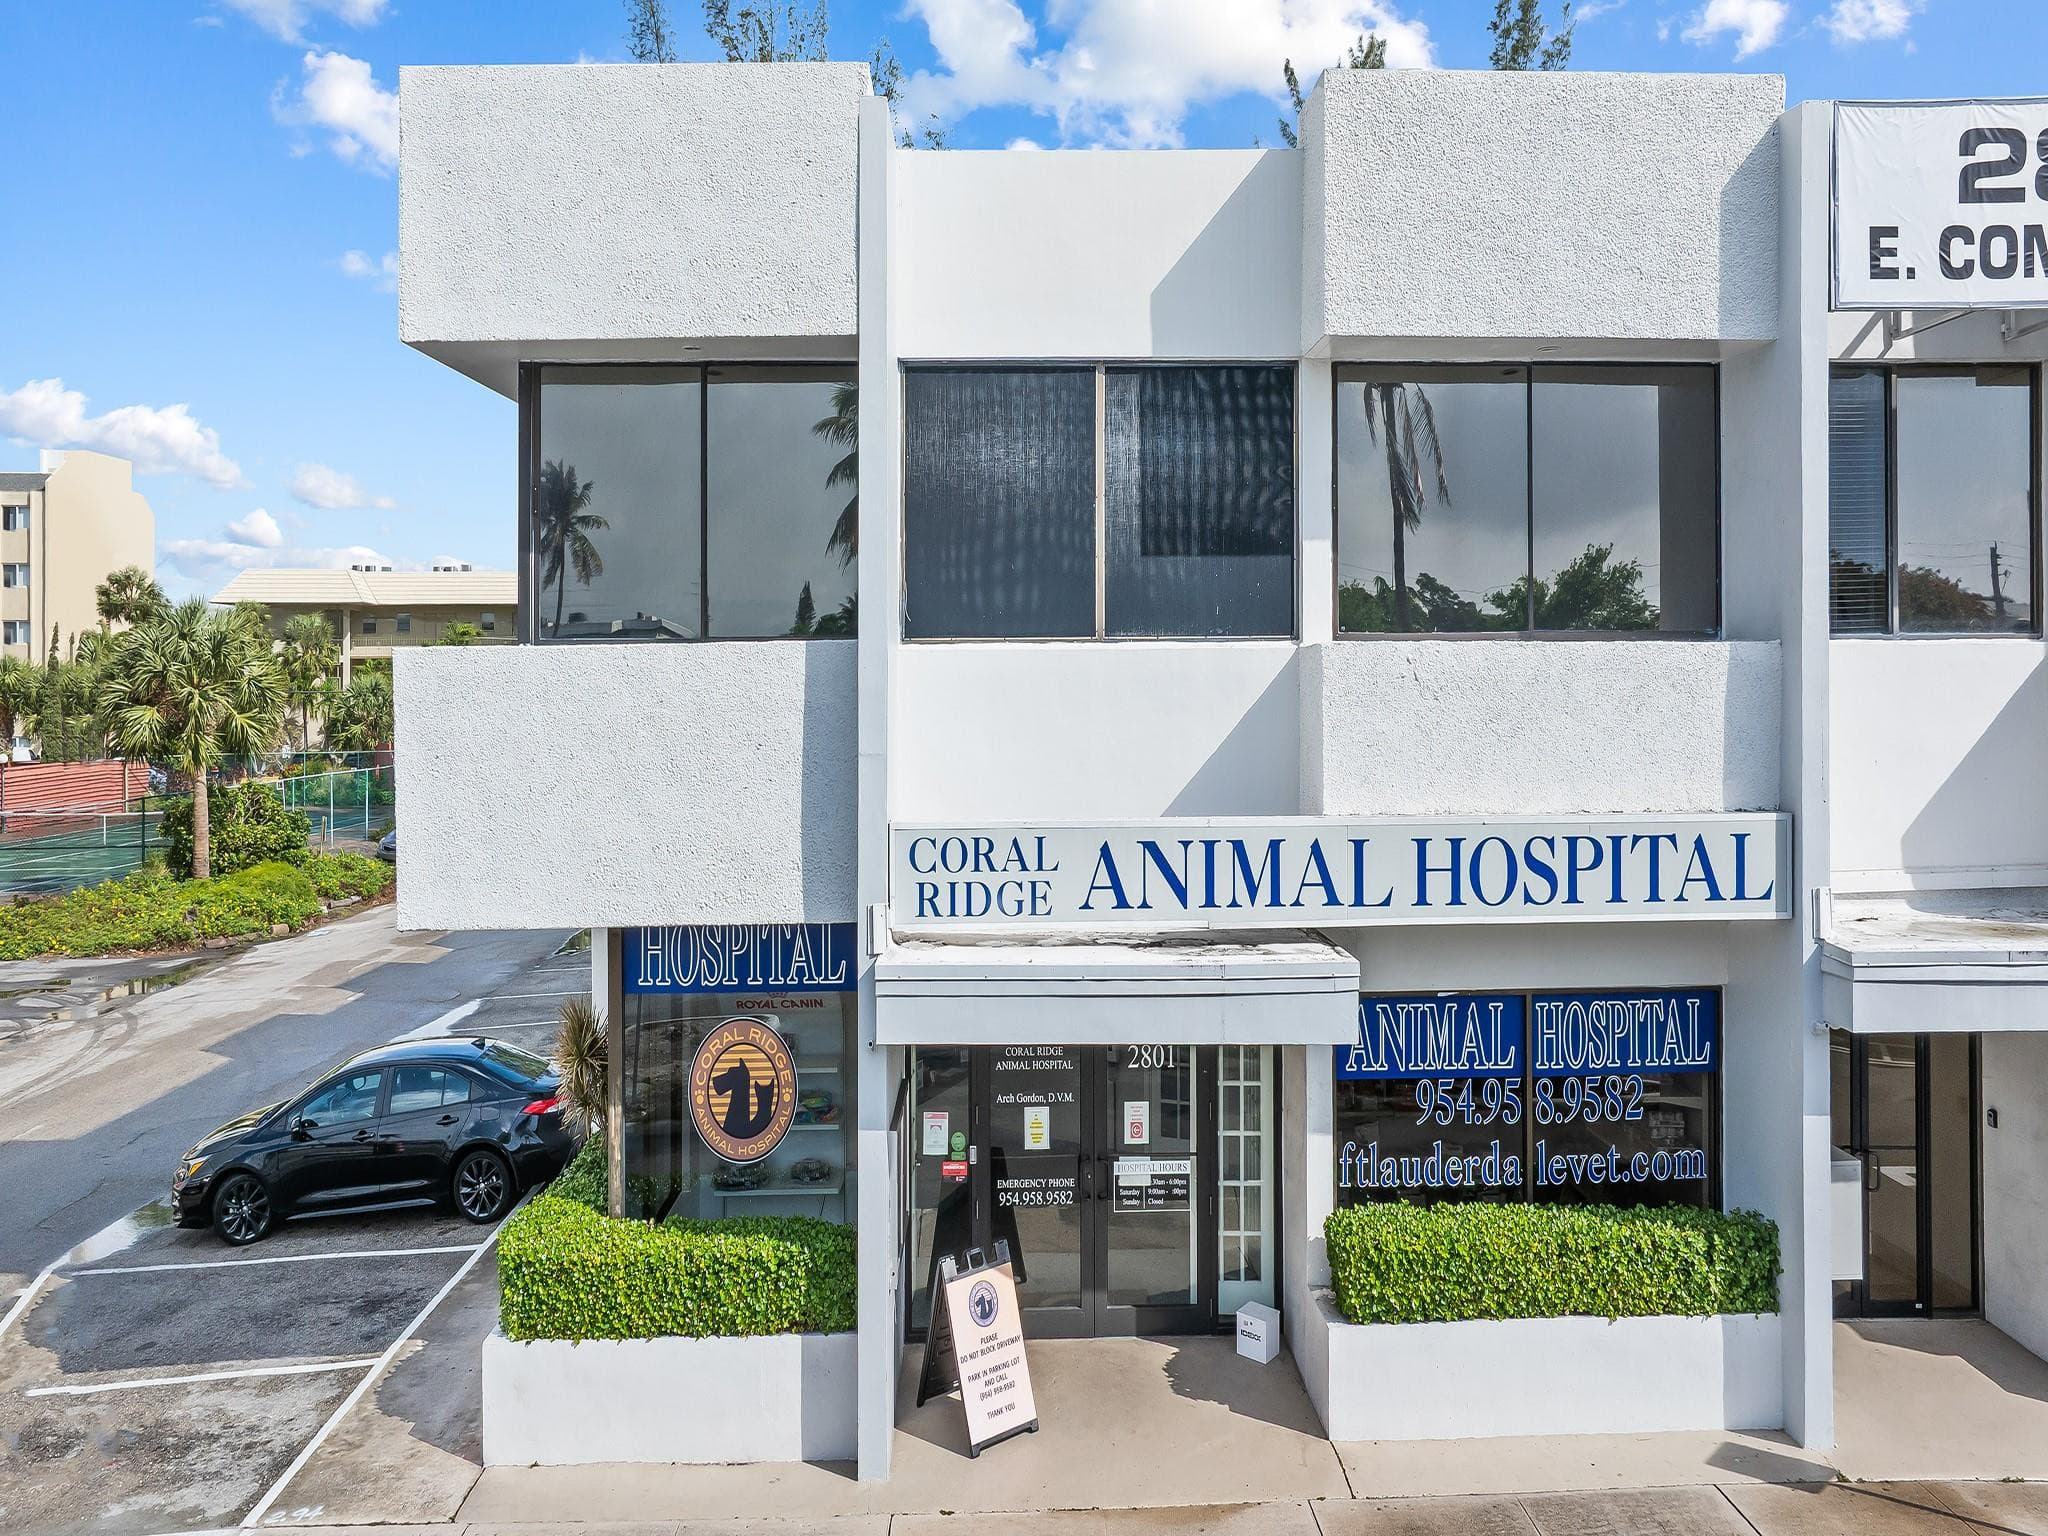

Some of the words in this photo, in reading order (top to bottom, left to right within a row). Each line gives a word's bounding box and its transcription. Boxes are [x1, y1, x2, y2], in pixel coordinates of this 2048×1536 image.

[1959, 127, 2048, 204] 2
[1869, 226, 1916, 280] E.
[909, 835, 1060, 874] CORAL
[1078, 837, 1394, 910] ANIMAL
[1411, 832, 1774, 907] HOSPITAL
[914, 880, 1054, 918] RIDGE
[638, 923, 847, 987] HOSPITAL
[736, 999, 778, 1010] ROYAL
[780, 998, 824, 1009] CANIN
[1345, 1002, 1516, 1072] ANIMAL
[1536, 998, 1711, 1070] HOSPITAL
[696, 1027, 745, 1086] CORAL
[749, 1027, 792, 1085] RIDGE
[1005, 1046, 1035, 1057] CORAL
[1037, 1046, 1064, 1056] RIDGE
[1127, 1044, 1175, 1069] 2801
[995, 1060, 1031, 1071] ANIMAL
[1032, 1060, 1074, 1070] HOSPITAL
[996, 1093, 1015, 1104] Arch
[1016, 1092, 1047, 1105] Gordon,
[1048, 1092, 1075, 1103] D.V.M.
[696, 1107, 735, 1154] ANIMAL
[738, 1106, 791, 1156] HOSPITAL
[1117, 1163, 1158, 1173] HOSPITAL
[1159, 1162, 1188, 1172] HOURS
[997, 1178, 1047, 1189] EMERGENCY
[1048, 1178, 1076, 1188] PHONE
[999, 1190, 1074, 1207] 954.958.9582
[960, 1354, 968, 1364] DO
[969, 1350, 979, 1361] NOT
[980, 1344, 996, 1357] BLOCK
[996, 1335, 1021, 1350] DRIVEWAY
[980, 1332, 999, 1345] PLEASE
[967, 1371, 981, 1383] PARK
[982, 1369, 988, 1378] IN
[988, 1360, 1010, 1374] PARKING
[1010, 1356, 1020, 1367] LOT
[984, 1378, 995, 1388] AND
[995, 1373, 1008, 1382] CALL
[987, 1406, 1005, 1420] THANK
[1004, 1402, 1016, 1413] YOU
